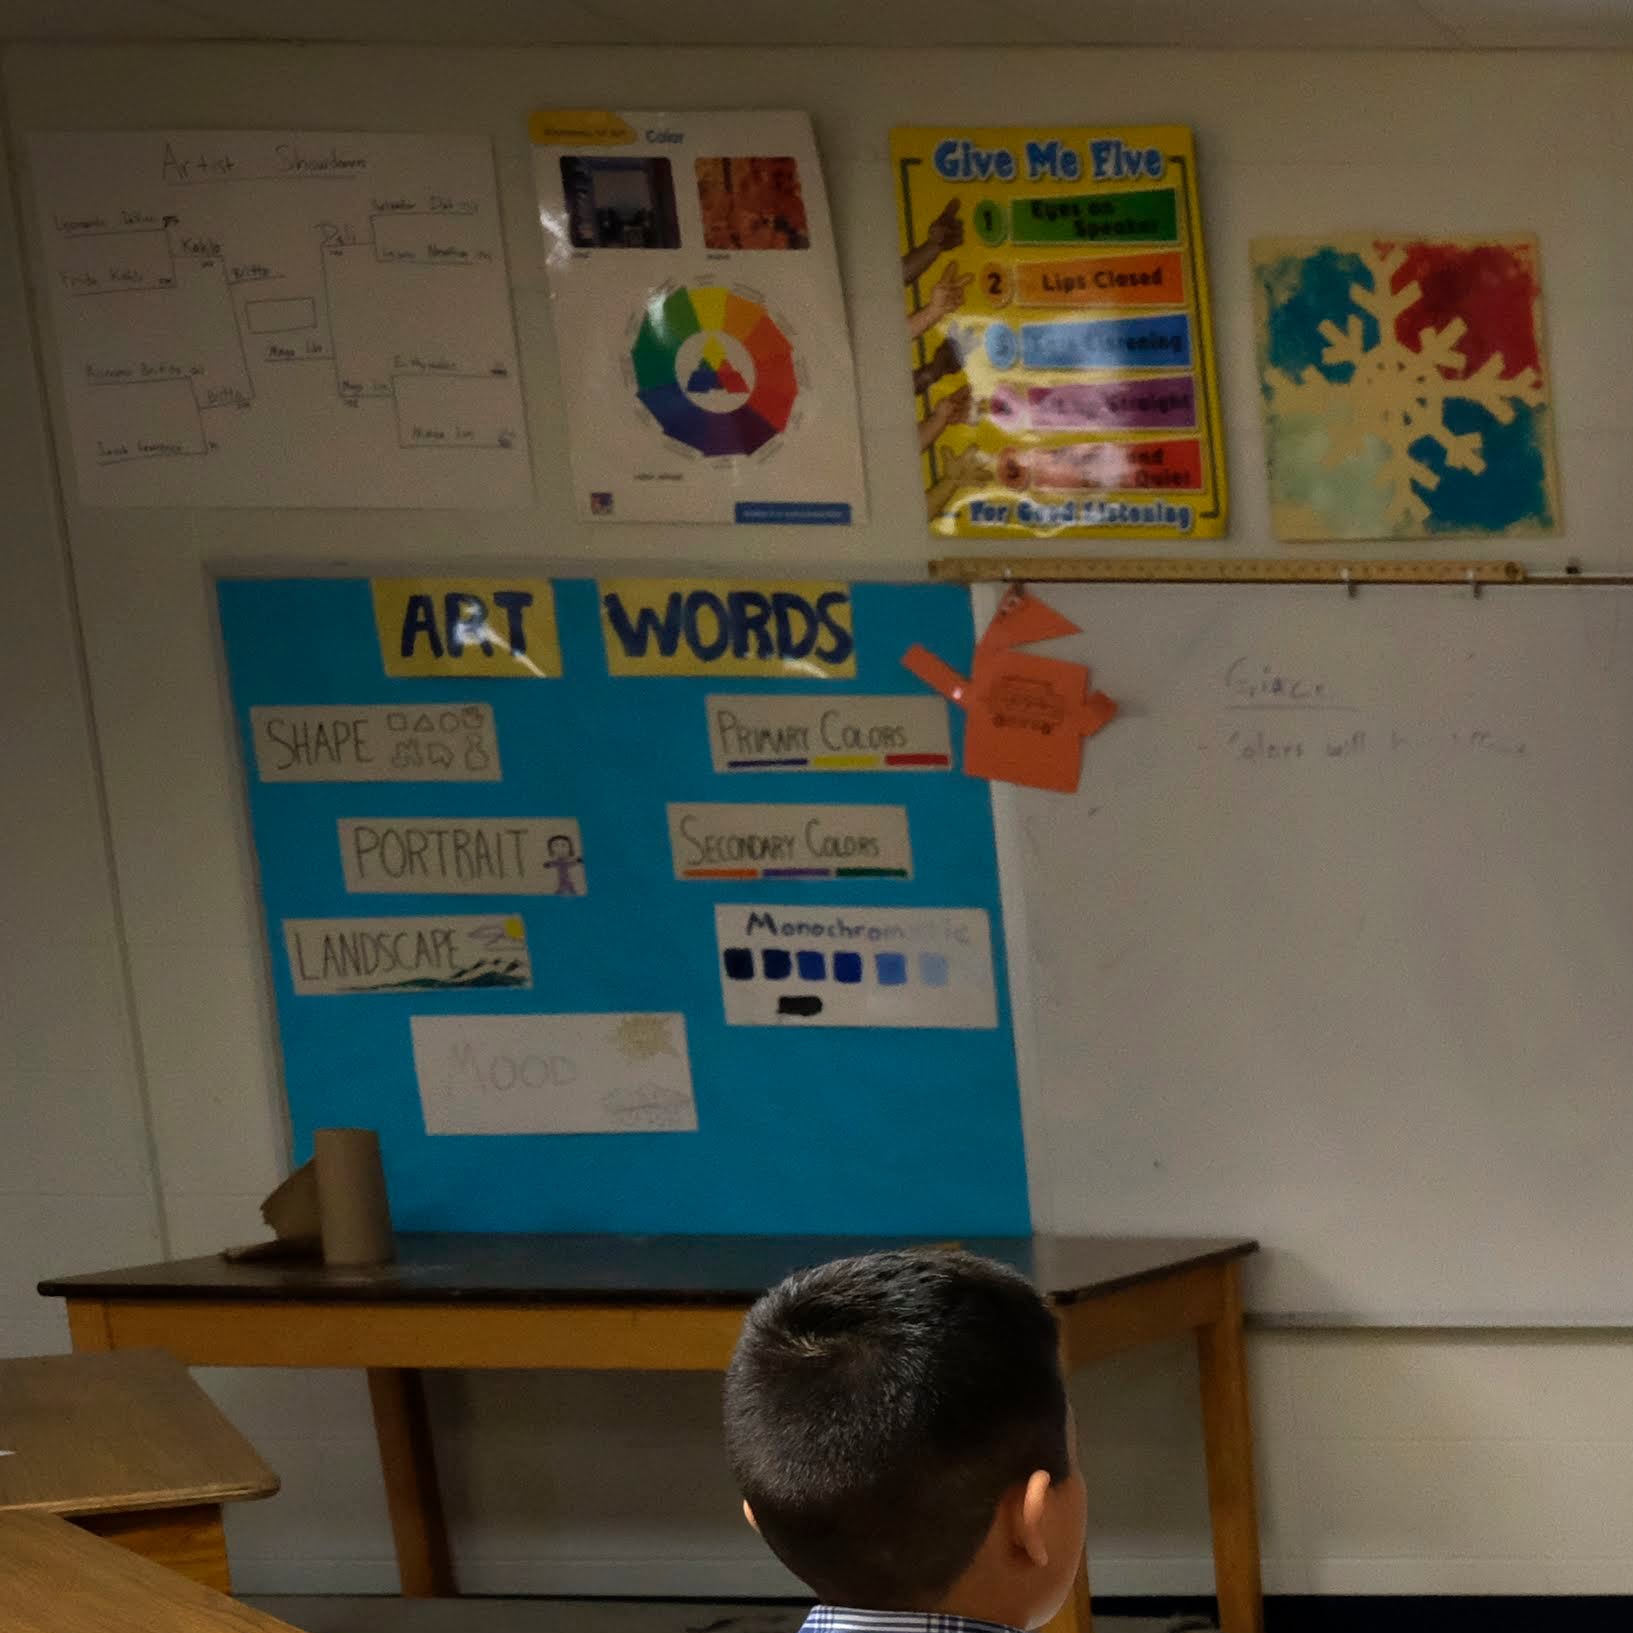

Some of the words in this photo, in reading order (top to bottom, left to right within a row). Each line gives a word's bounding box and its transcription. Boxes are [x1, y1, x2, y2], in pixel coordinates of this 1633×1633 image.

[935, 138, 1016, 180] Give
[1025, 138, 1082, 180] Me
[1090, 138, 1164, 180] Five
[984, 210, 994, 232] 1
[987, 272, 1003, 295] 2
[1042, 274, 1087, 294] Lips
[1093, 266, 1165, 290] Closed
[968, 500, 1009, 523] For
[401, 592, 533, 660] ART
[603, 590, 856, 665] WORDS
[267, 716, 374, 771] SHAPE
[353, 826, 529, 880] PORTRAIT
[295, 928, 460, 982] LANDSCAPE
